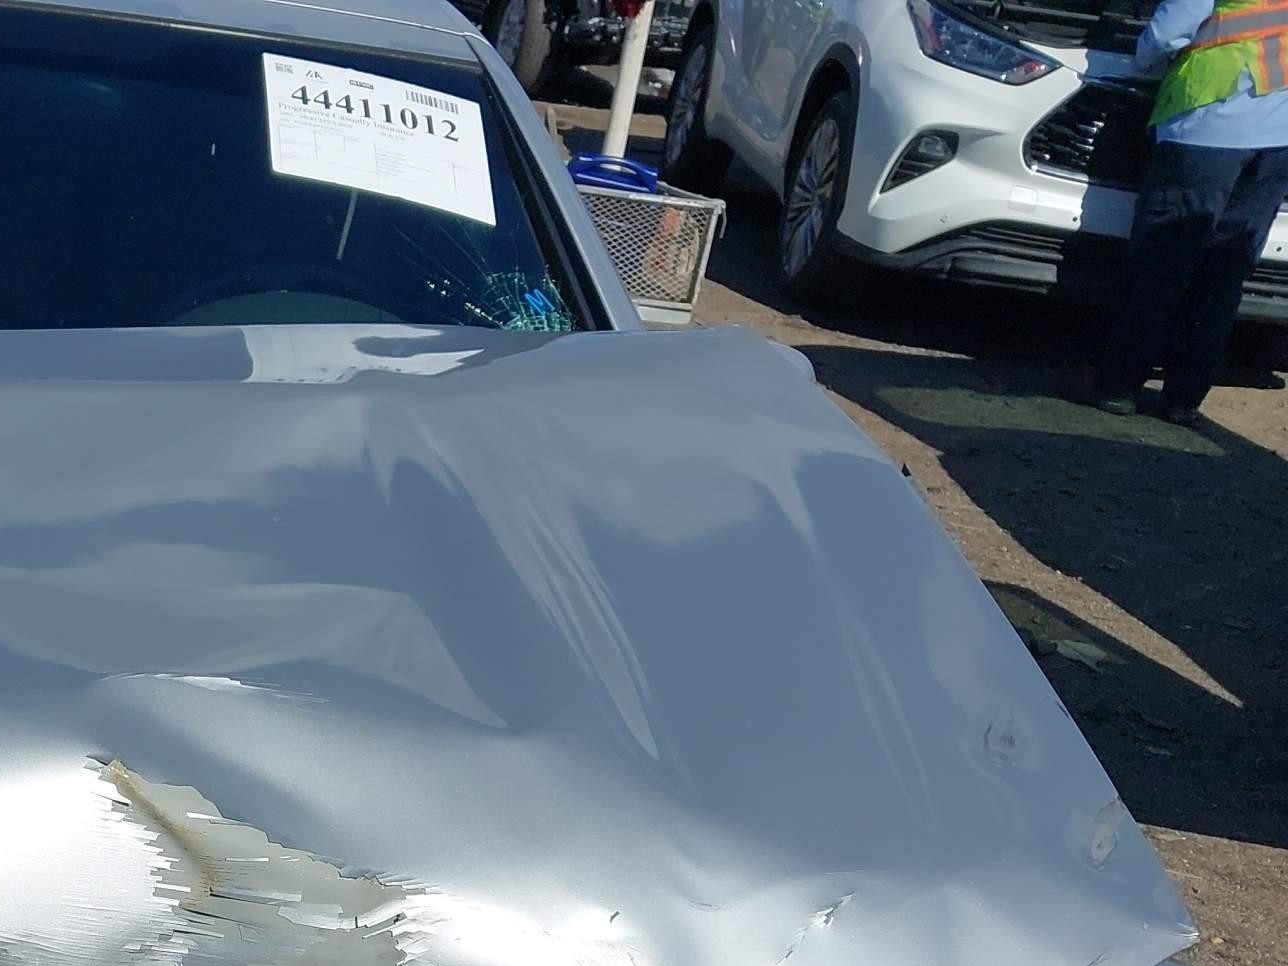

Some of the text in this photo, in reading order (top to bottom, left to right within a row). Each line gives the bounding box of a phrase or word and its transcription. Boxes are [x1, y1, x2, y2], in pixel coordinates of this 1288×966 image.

[278, 102, 331, 118] Progressive
[331, 112, 370, 128] Casualty
[291, 85, 460, 142] 44411012
